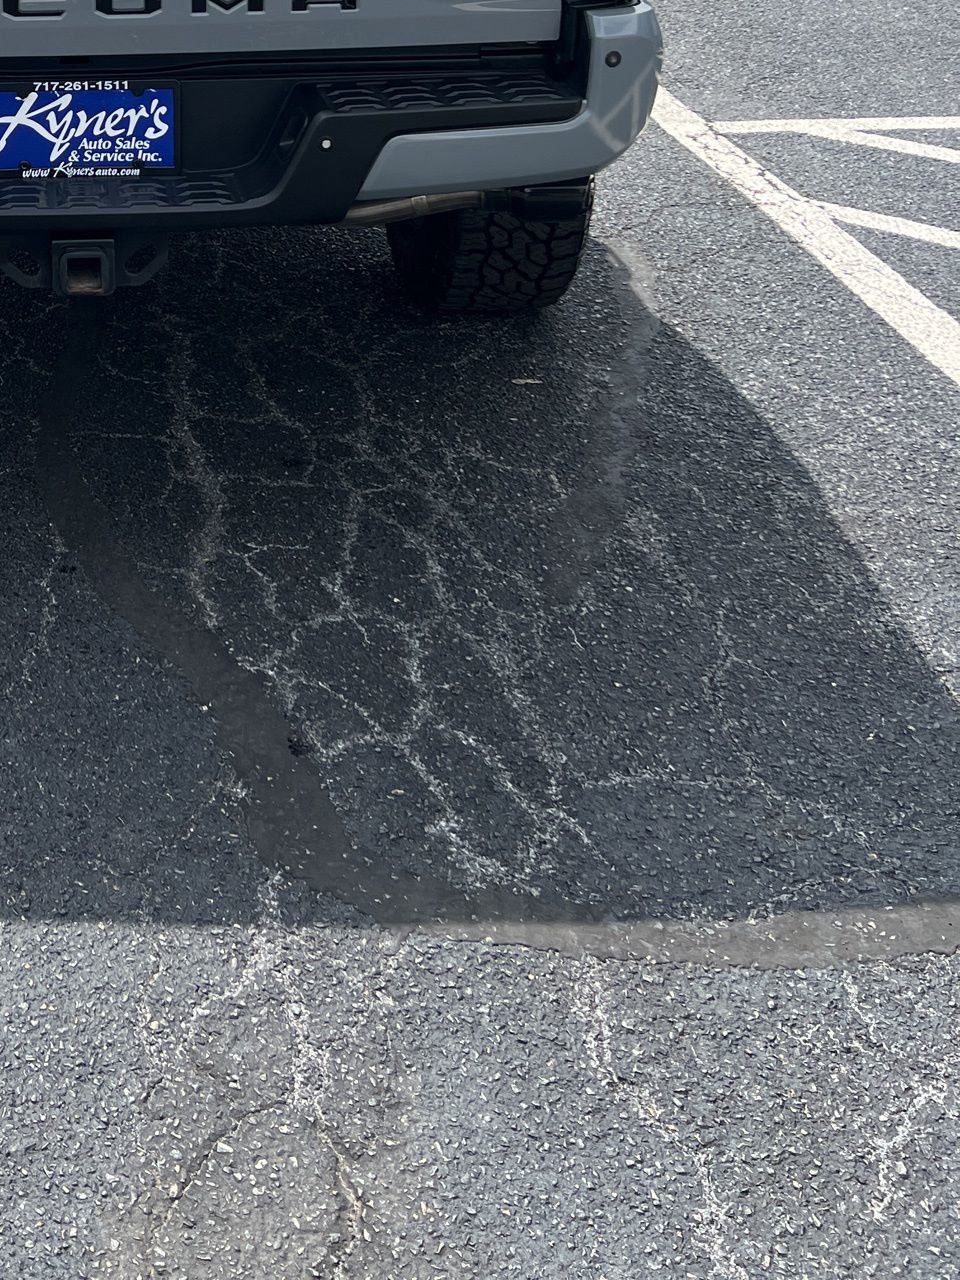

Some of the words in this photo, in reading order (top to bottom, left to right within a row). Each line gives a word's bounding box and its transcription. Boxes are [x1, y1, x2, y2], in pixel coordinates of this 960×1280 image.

[33, 80, 129, 91] 717-261-1511
[78, 138, 112, 150] Auto
[114, 137, 150, 150] Sales
[68, 150, 80, 162] &
[83, 150, 135, 162] Service
[137, 150, 163, 162] Inc.
